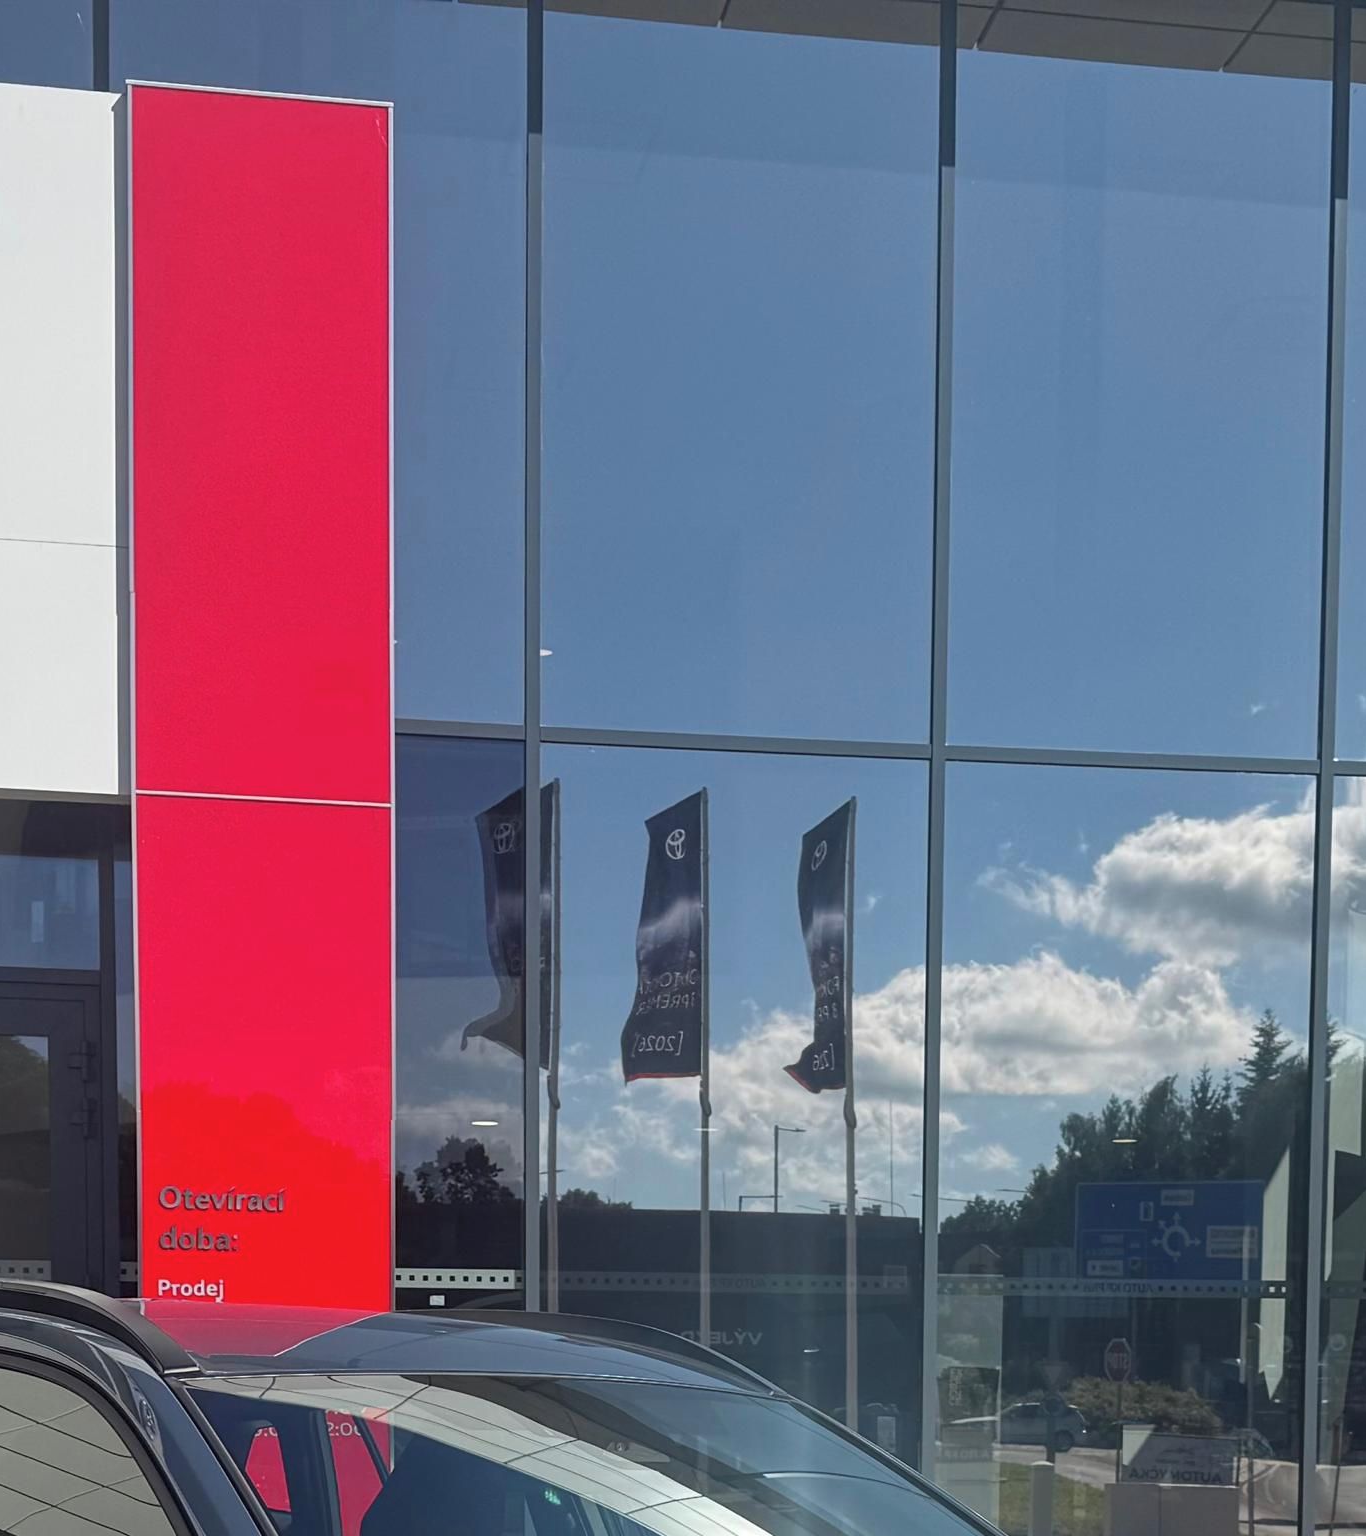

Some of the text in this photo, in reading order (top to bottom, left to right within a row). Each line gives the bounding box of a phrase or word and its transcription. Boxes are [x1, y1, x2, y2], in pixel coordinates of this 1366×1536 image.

[158, 1185, 286, 1213] Otevírací
[158, 1226, 239, 1252] doba:
[157, 1279, 224, 1304] Prodej
